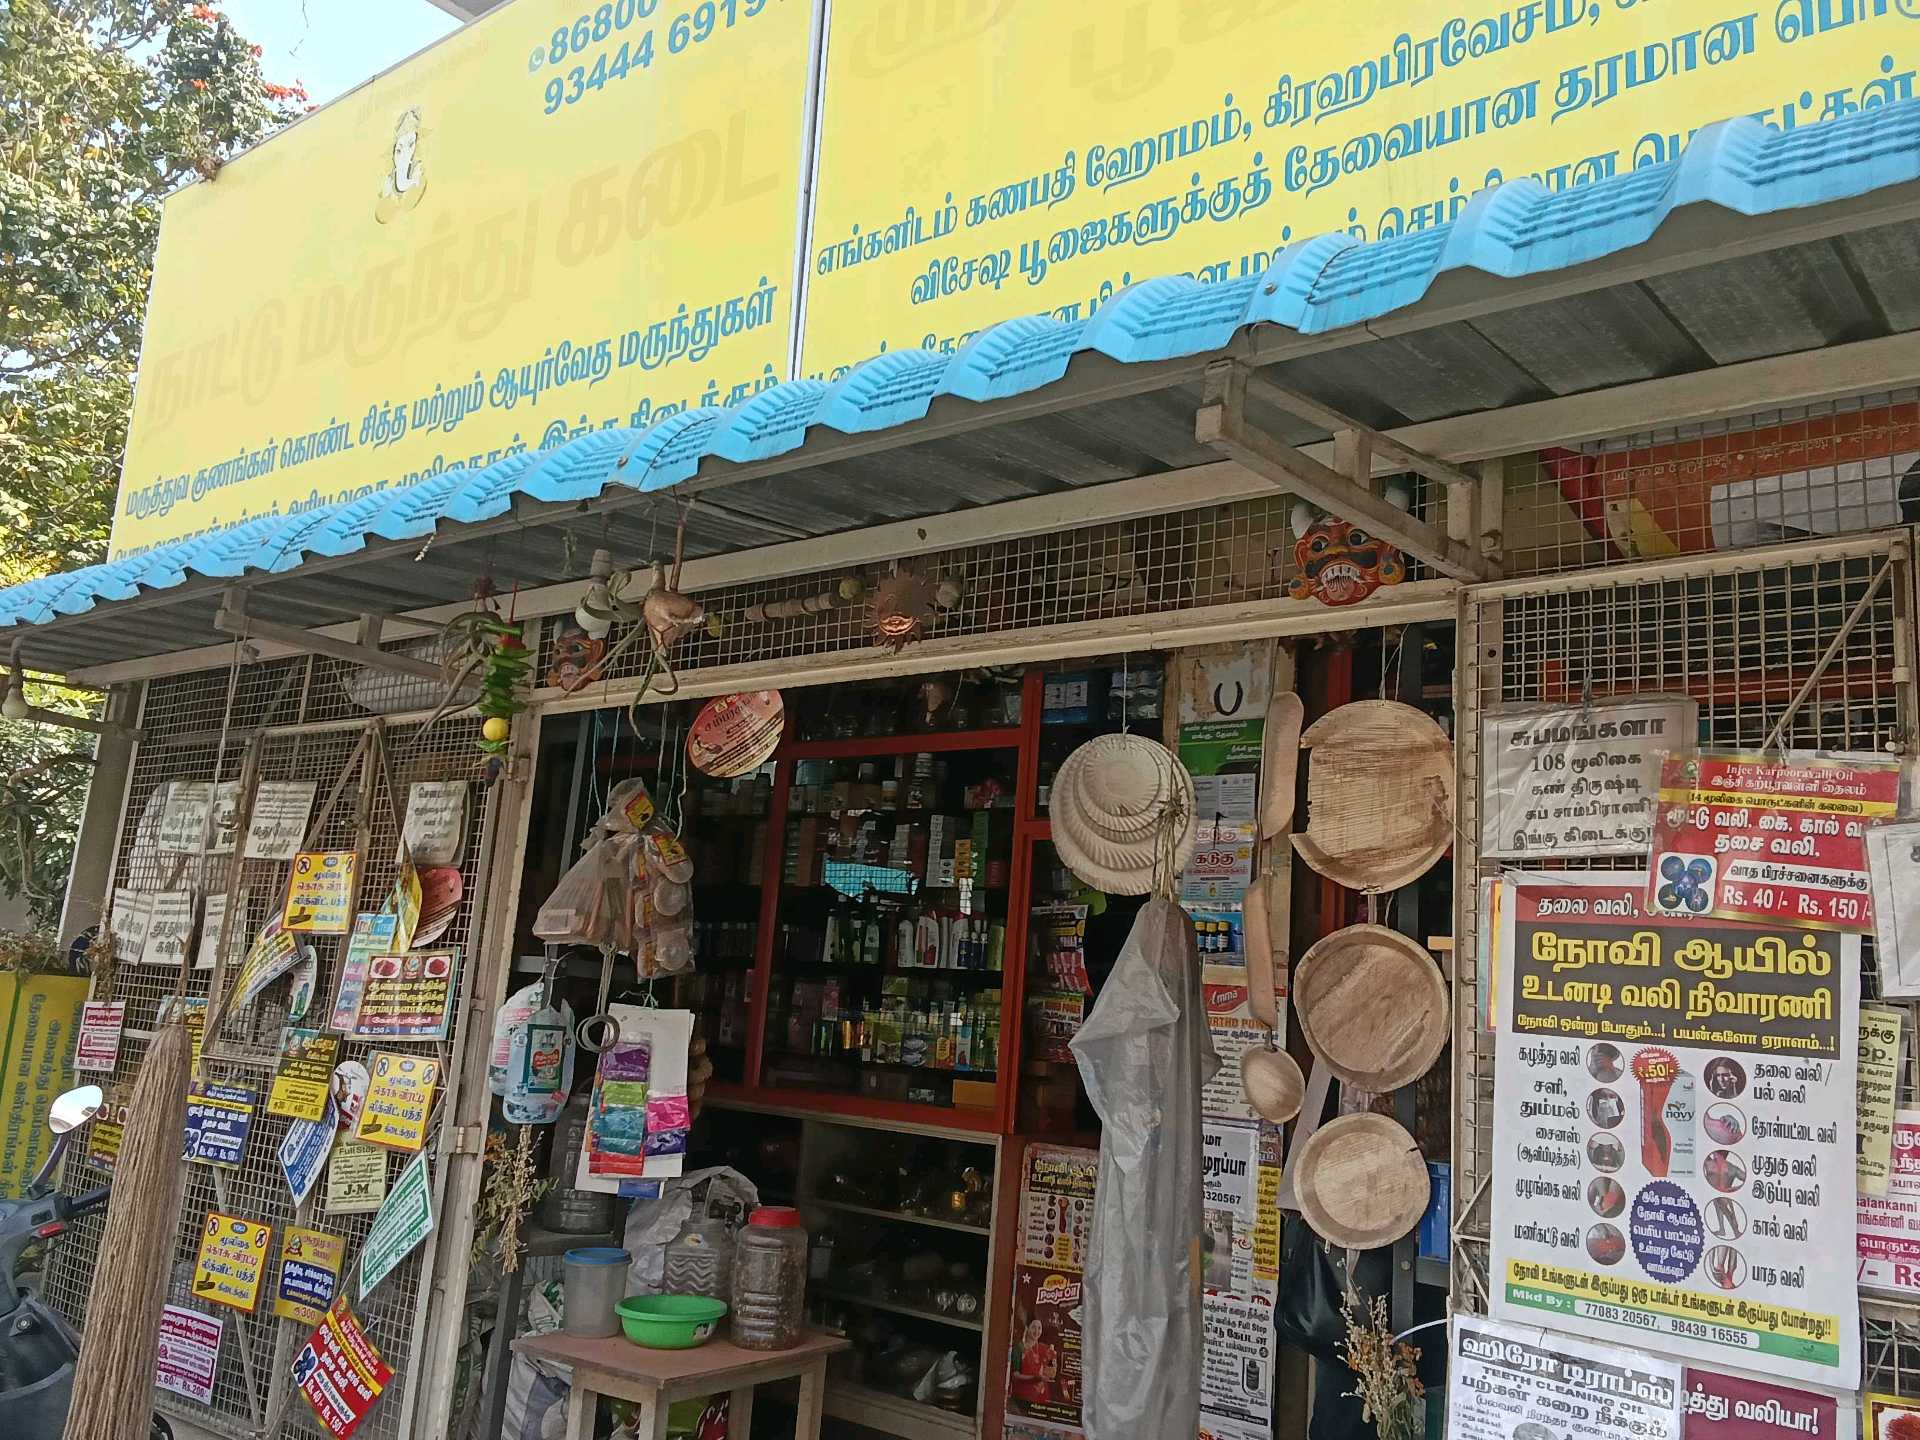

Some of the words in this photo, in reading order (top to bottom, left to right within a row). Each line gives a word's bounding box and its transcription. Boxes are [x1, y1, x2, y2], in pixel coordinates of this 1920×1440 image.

[544, 30, 654, 115] 93444
[911, 247, 1010, 307] விசேஷ
[1019, 152, 1272, 286] பூஜைகளுக்குத்
[1284, 80, 1540, 200] தேவையான
[1551, 12, 1758, 126] தரமான
[816, 192, 957, 276] எங்களிடம்
[966, 150, 1075, 212] கணபதி
[1086, 93, 1252, 195] ஹோமம்,
[300, 205, 540, 366] மருந்து
[558, 110, 781, 270] கடை
[125, 475, 190, 521] மருத்துவ
[190, 438, 279, 503] குணங்கள்
[280, 416, 354, 468] கொண்ட
[359, 401, 408, 451] சித்த
[411, 371, 485, 435] மற்றும்
[490, 340, 612, 409] ஆயுர்வேத
[618, 276, 778, 371] மருந்துகள்
[1531, 753, 1566, 773] 108
[1571, 751, 1642, 774] மூலிகை
[1836, 771, 1854, 782] Oil
[1531, 778, 1566, 797] கண்
[1570, 774, 1643, 798] திருஷ்டி
[1513, 828, 1559, 851] இங்கு
[1563, 822, 1652, 845] கிடைக்கு
[1800, 813, 1840, 836] கால்
[1714, 833, 1765, 855] தசை
[1731, 863, 1760, 879] வாத
[1536, 895, 1590, 919] தலை
[1723, 884, 1748, 907] Rs.
[1753, 886, 1775, 910] 40
[1797, 893, 1823, 917] Rs.
[1829, 897, 1859, 921] 150
[1531, 931, 1662, 973] நோவி
[1673, 934, 1833, 981] ஆயில்
[1521, 975, 1614, 1014] உடனடி
[1621, 977, 1682, 1011] வலி
[1685, 978, 1833, 1024] நிவாரணி
[1517, 1013, 1559, 1031] நோவி
[1560, 1016, 1600, 1036] ஒன்று
[1673, 1023, 1758, 1046] பயன்களோ
[1518, 1043, 1559, 1068] கழுத்து
[1559, 1044, 1582, 1066] வலி
[1753, 1061, 1793, 1082] தலை
[1794, 1063, 1823, 1086] வலி
[1519, 1096, 1581, 1120] தும்மல்
[1753, 1082, 1777, 1102] பல்
[1778, 1083, 1807, 1106] வலி
[1666, 1110, 1695, 1122] novy
[1751, 1115, 1816, 1141] தோள்பட்டை
[1817, 1122, 1838, 1145] வலி
[1535, 1125, 1582, 1145] சைனஸ்
[1751, 1153, 1791, 1178] முதுகு
[1792, 1154, 1818, 1179] வலி
[1514, 1174, 1561, 1201] முழங்கை
[1561, 1179, 1582, 1203] வலி
[1751, 1179, 1795, 1207] இடுப்பு
[1795, 1183, 1821, 1208] வலி
[1637, 1206, 1665, 1222] நோவி
[1752, 1213, 1783, 1239] கால்
[1784, 1217, 1809, 1243] வலி
[1559, 1223, 1581, 1249] வலி
[1751, 1264, 1779, 1288] பாத
[1780, 1265, 1805, 1290] வலி
[1513, 1262, 1540, 1282] நோவி
[1541, 1267, 1589, 1291] உங்களுடன்
[1590, 1274, 1629, 1304] இருப்பது
[1631, 1286, 1648, 1304] ஒரு
[1649, 1286, 1680, 1307] டாக்டர்
[1681, 1290, 1735, 1316] உங்களுடன்
[1737, 1299, 1779, 1331] இருப்பது
[1513, 1288, 1543, 1304] Mkd
[1545, 1292, 1564, 1309] By
[1584, 1303, 1620, 1321] 77083
[1671, 1319, 1707, 1338] 98439
[1711, 1326, 1748, 1345] 16555
[1461, 1374, 1531, 1402] பற்கள்
[1536, 1395, 1590, 1419] கறை
[1482, 1366, 1532, 1386] TEETH
[1536, 1378, 1615, 1407] CLEANING
[1619, 1401, 1647, 1415] OIL
[1735, 1398, 1820, 1435] வலியா!
